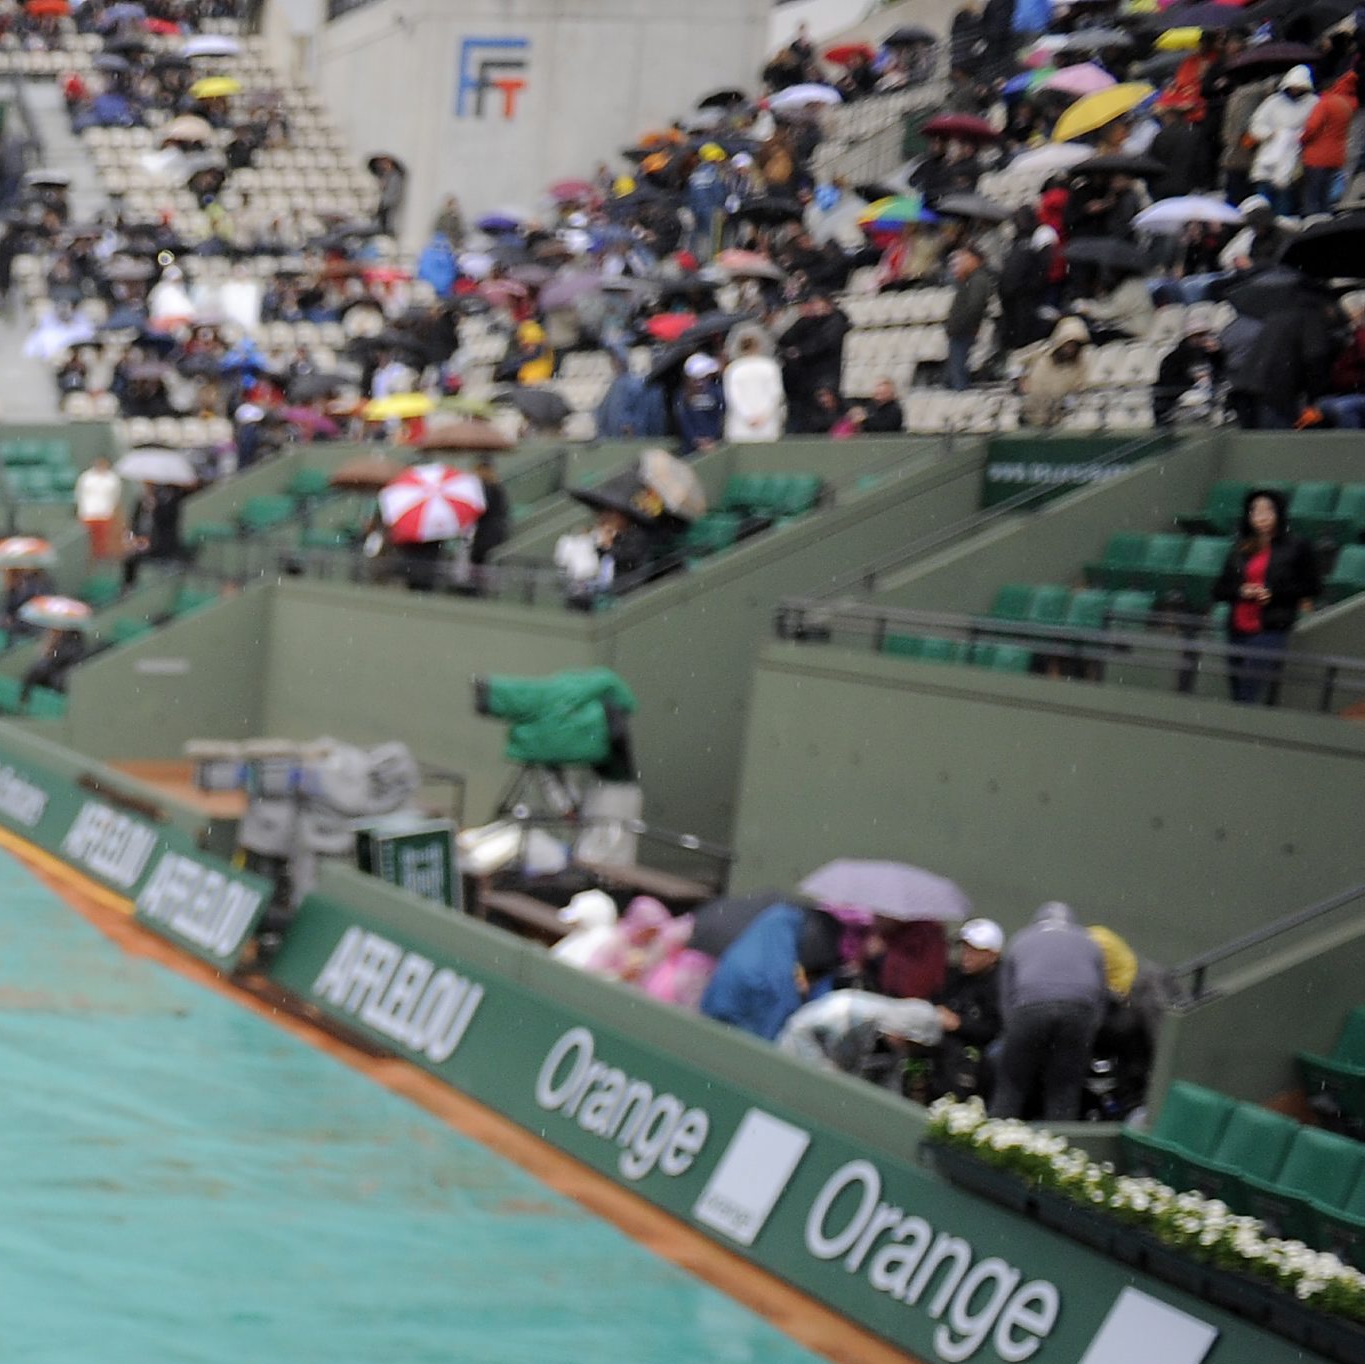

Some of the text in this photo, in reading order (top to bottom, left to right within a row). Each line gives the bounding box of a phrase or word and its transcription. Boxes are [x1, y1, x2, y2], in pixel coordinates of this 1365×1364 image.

[312, 926, 484, 1062] AFFLELOU
[535, 1027, 710, 1181] Orange
[805, 1158, 1061, 1363] Orange
